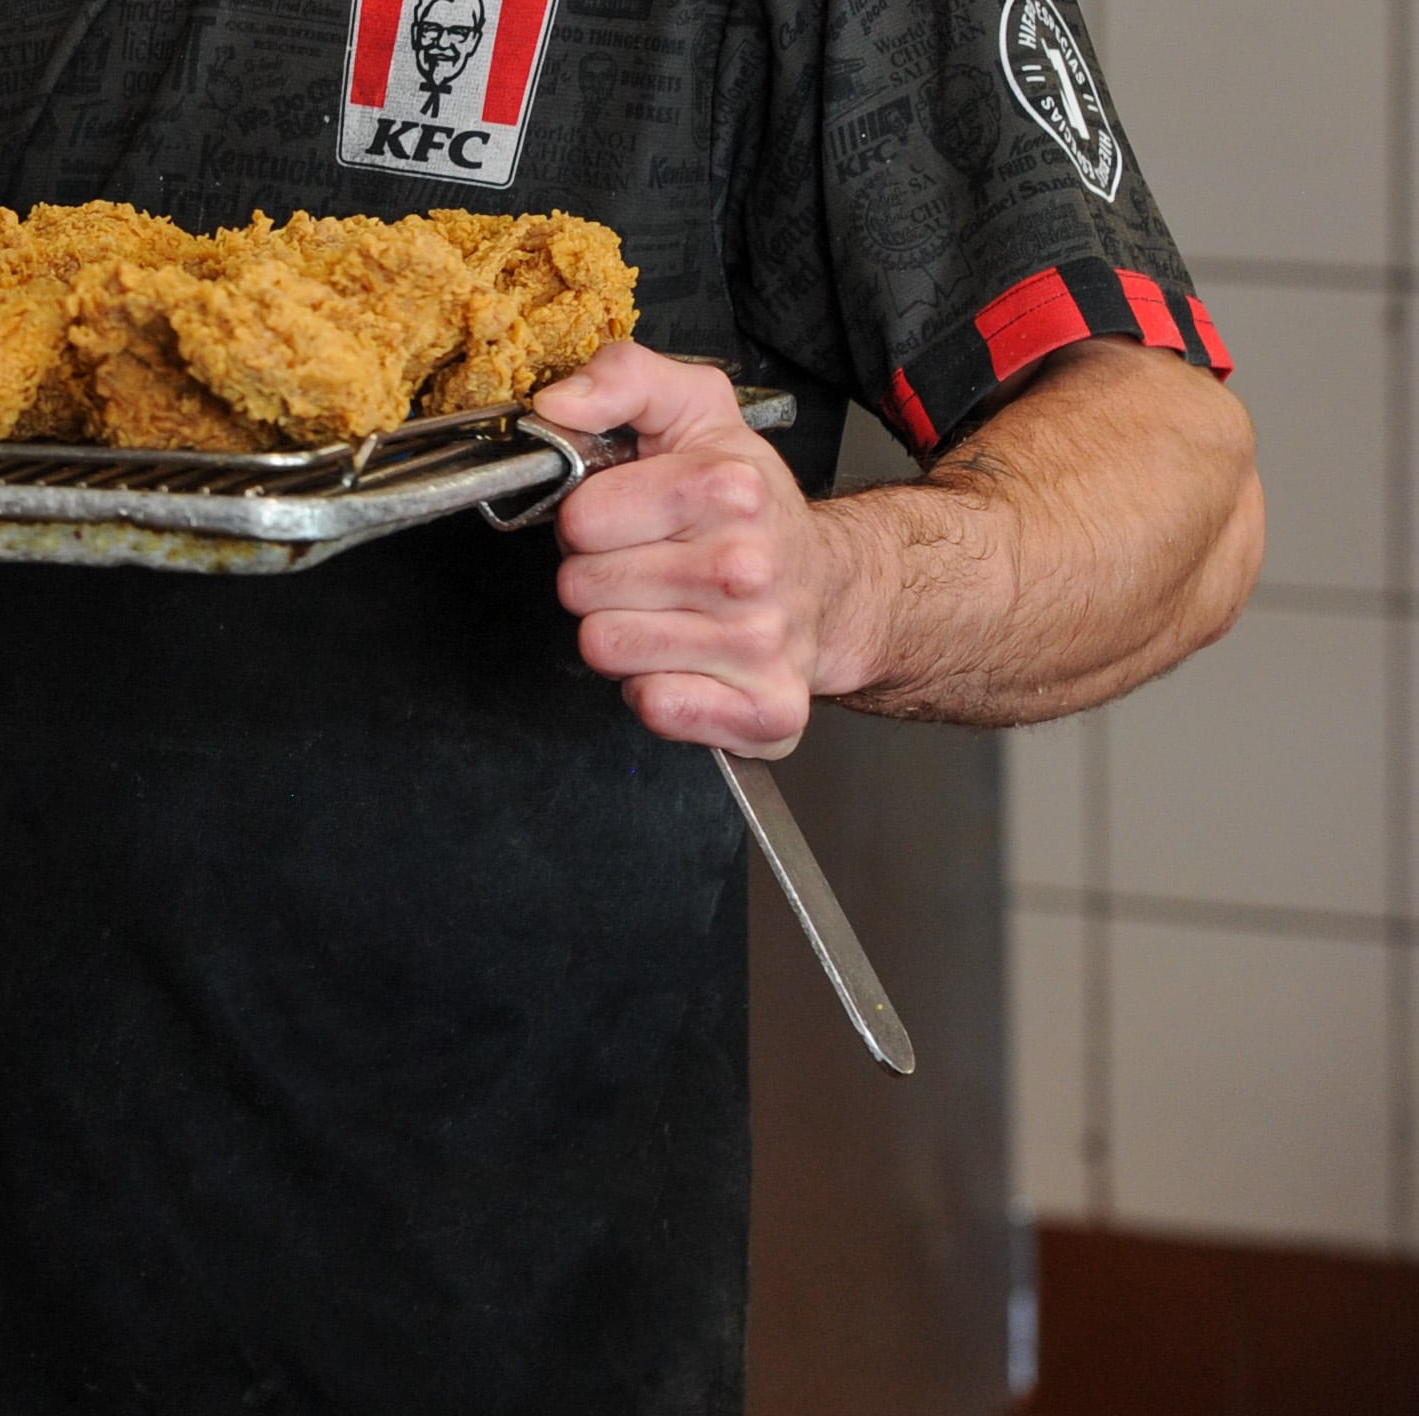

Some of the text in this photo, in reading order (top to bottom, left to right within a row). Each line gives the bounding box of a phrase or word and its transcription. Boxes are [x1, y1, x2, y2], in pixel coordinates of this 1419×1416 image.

[550, 23, 584, 44] OOD
[365, 118, 491, 170] KFC
[836, 138, 899, 185] KFC
[1018, 172, 1078, 201] Sand
